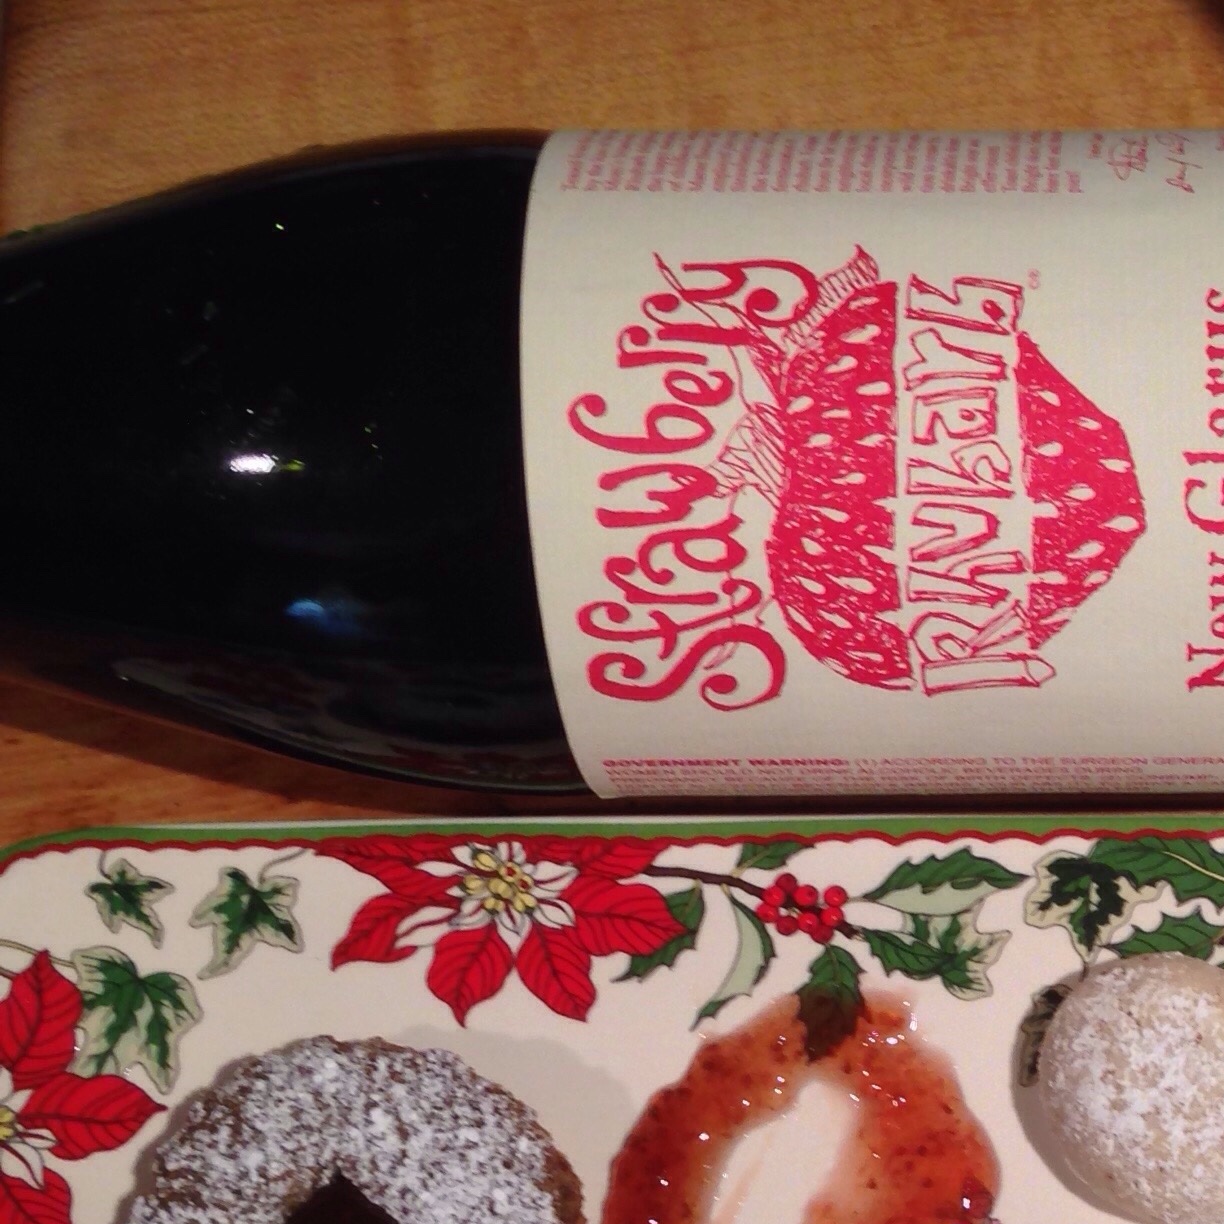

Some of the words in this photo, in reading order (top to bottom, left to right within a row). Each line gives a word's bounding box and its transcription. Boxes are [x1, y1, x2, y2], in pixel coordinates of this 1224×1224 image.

[567, 252, 822, 712] Strawberry
[903, 272, 1057, 698] Rhubarb
[602, 758, 741, 768] GOVERNMENT
